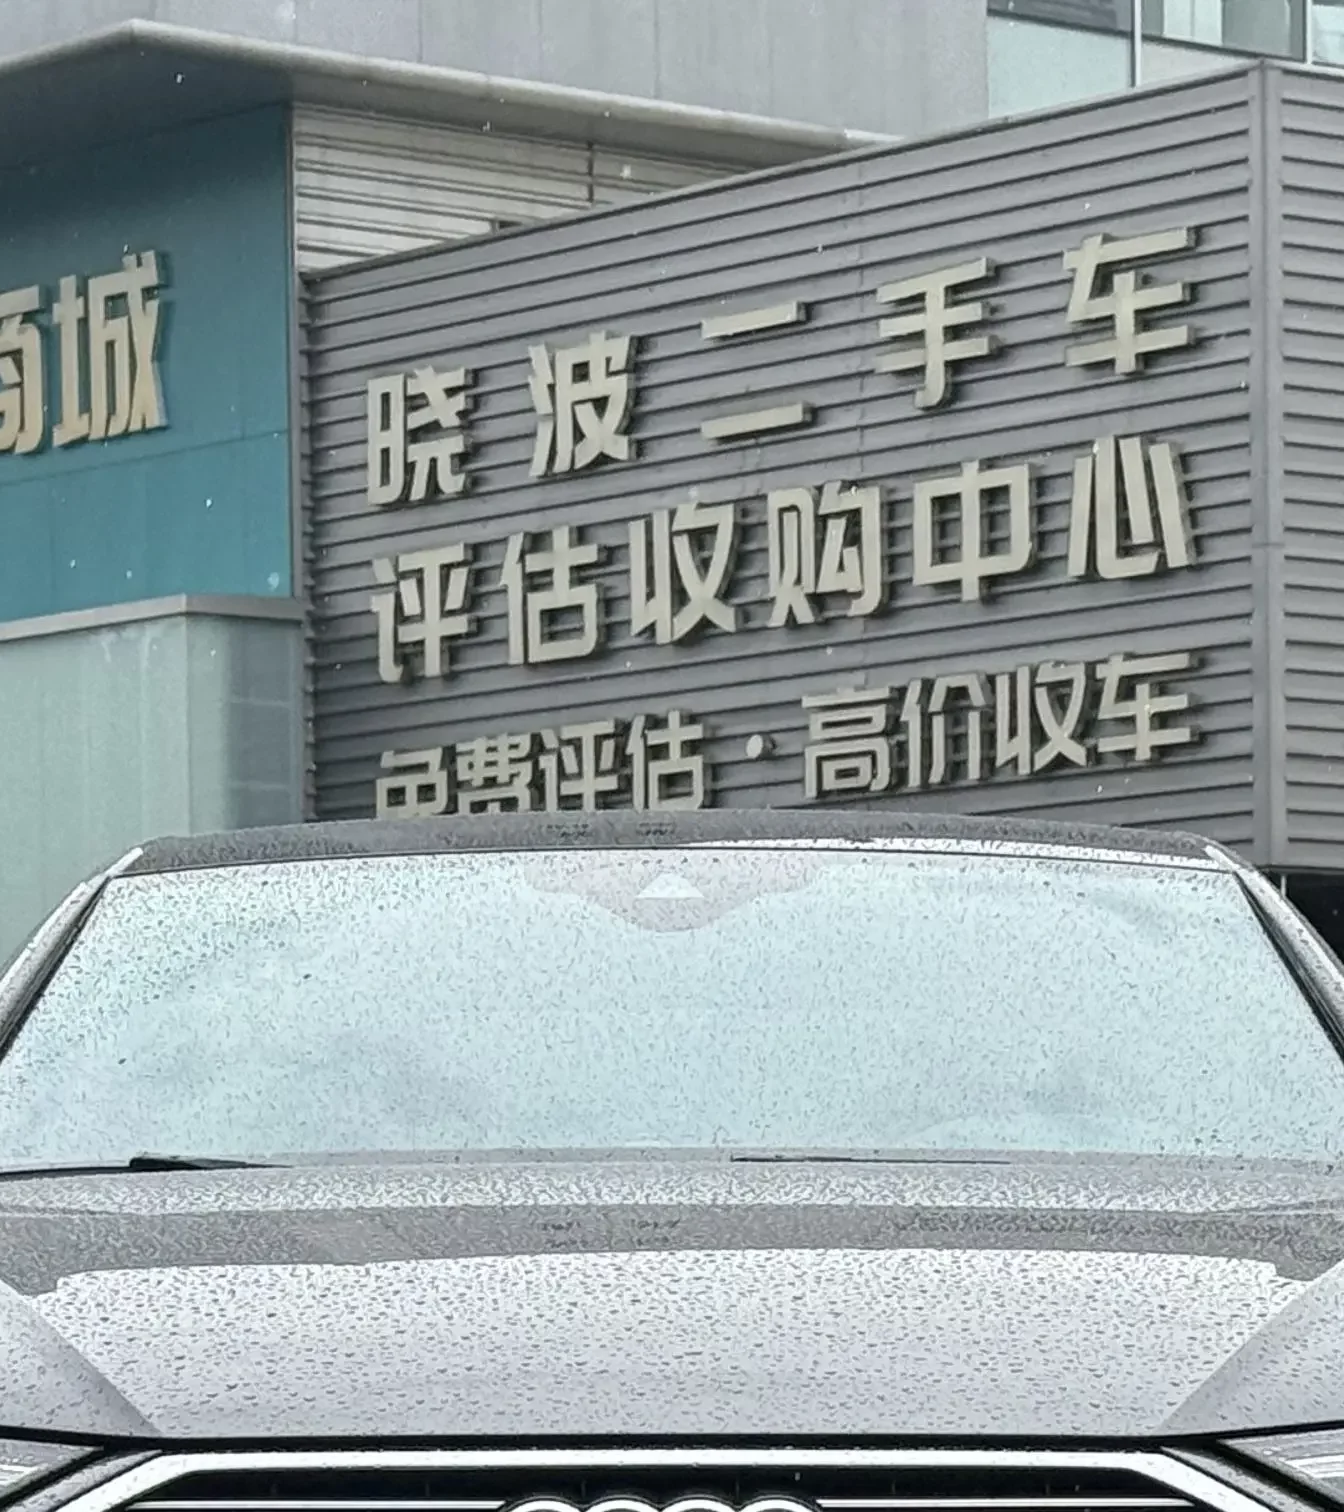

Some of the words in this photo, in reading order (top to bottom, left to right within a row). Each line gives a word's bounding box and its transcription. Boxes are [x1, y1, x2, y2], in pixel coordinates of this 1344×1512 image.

[367, 226, 1197, 505] 晓波二手车
[370, 435, 1196, 683] 评估收购中心
